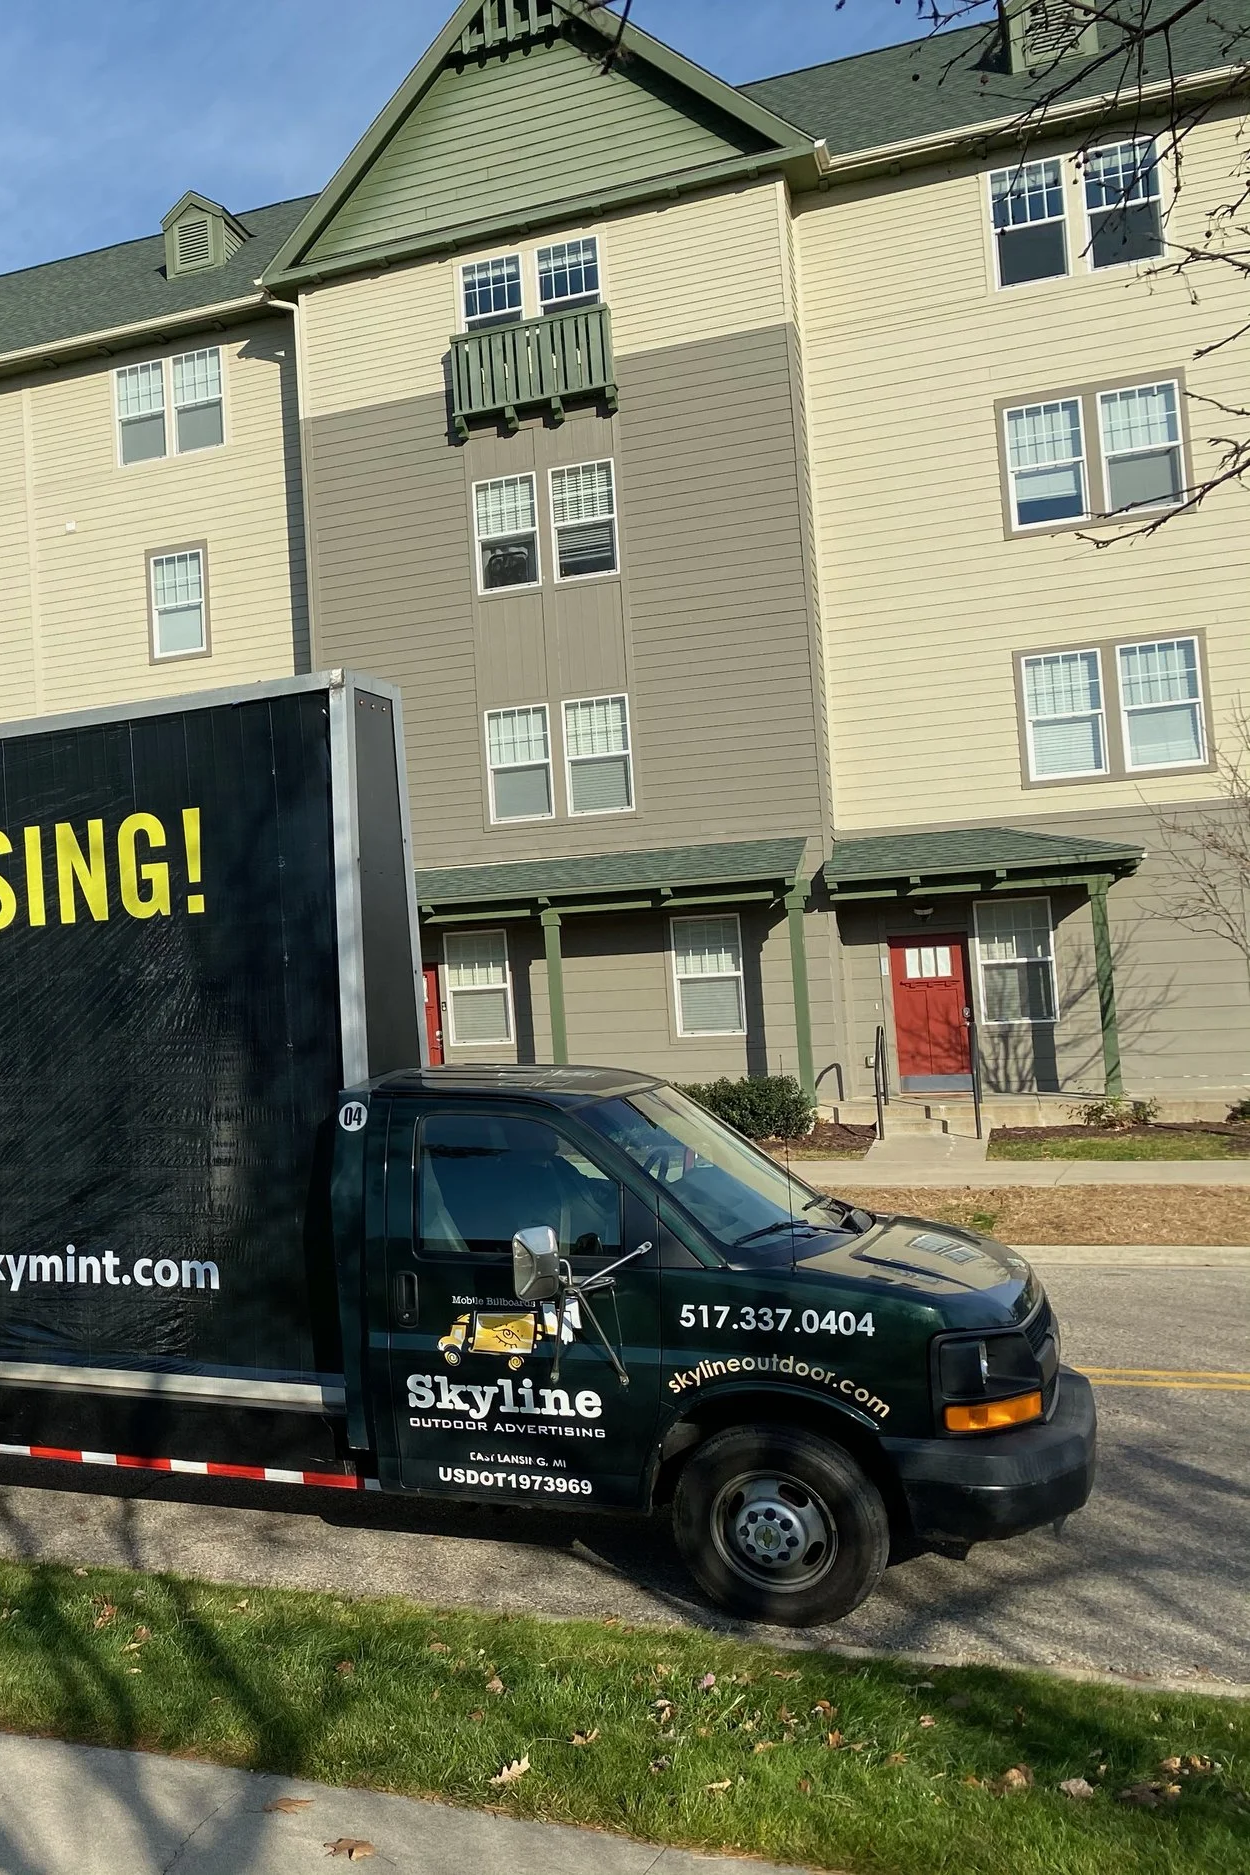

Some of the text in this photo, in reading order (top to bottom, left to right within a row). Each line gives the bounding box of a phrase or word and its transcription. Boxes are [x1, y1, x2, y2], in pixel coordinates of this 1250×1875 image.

[343, 1106, 363, 1126] 04
[451, 1295, 484, 1306] Mobile
[679, 1303, 876, 1337] 517.337.0404
[406, 1374, 602, 1419] Skyline
[668, 1353, 891, 1418] skylineoutdoor.com
[409, 1417, 606, 1438] OUTDOOR ADVERTISING
[552, 1459, 567, 1469] MI
[438, 1466, 593, 1496] USDOT1973969
